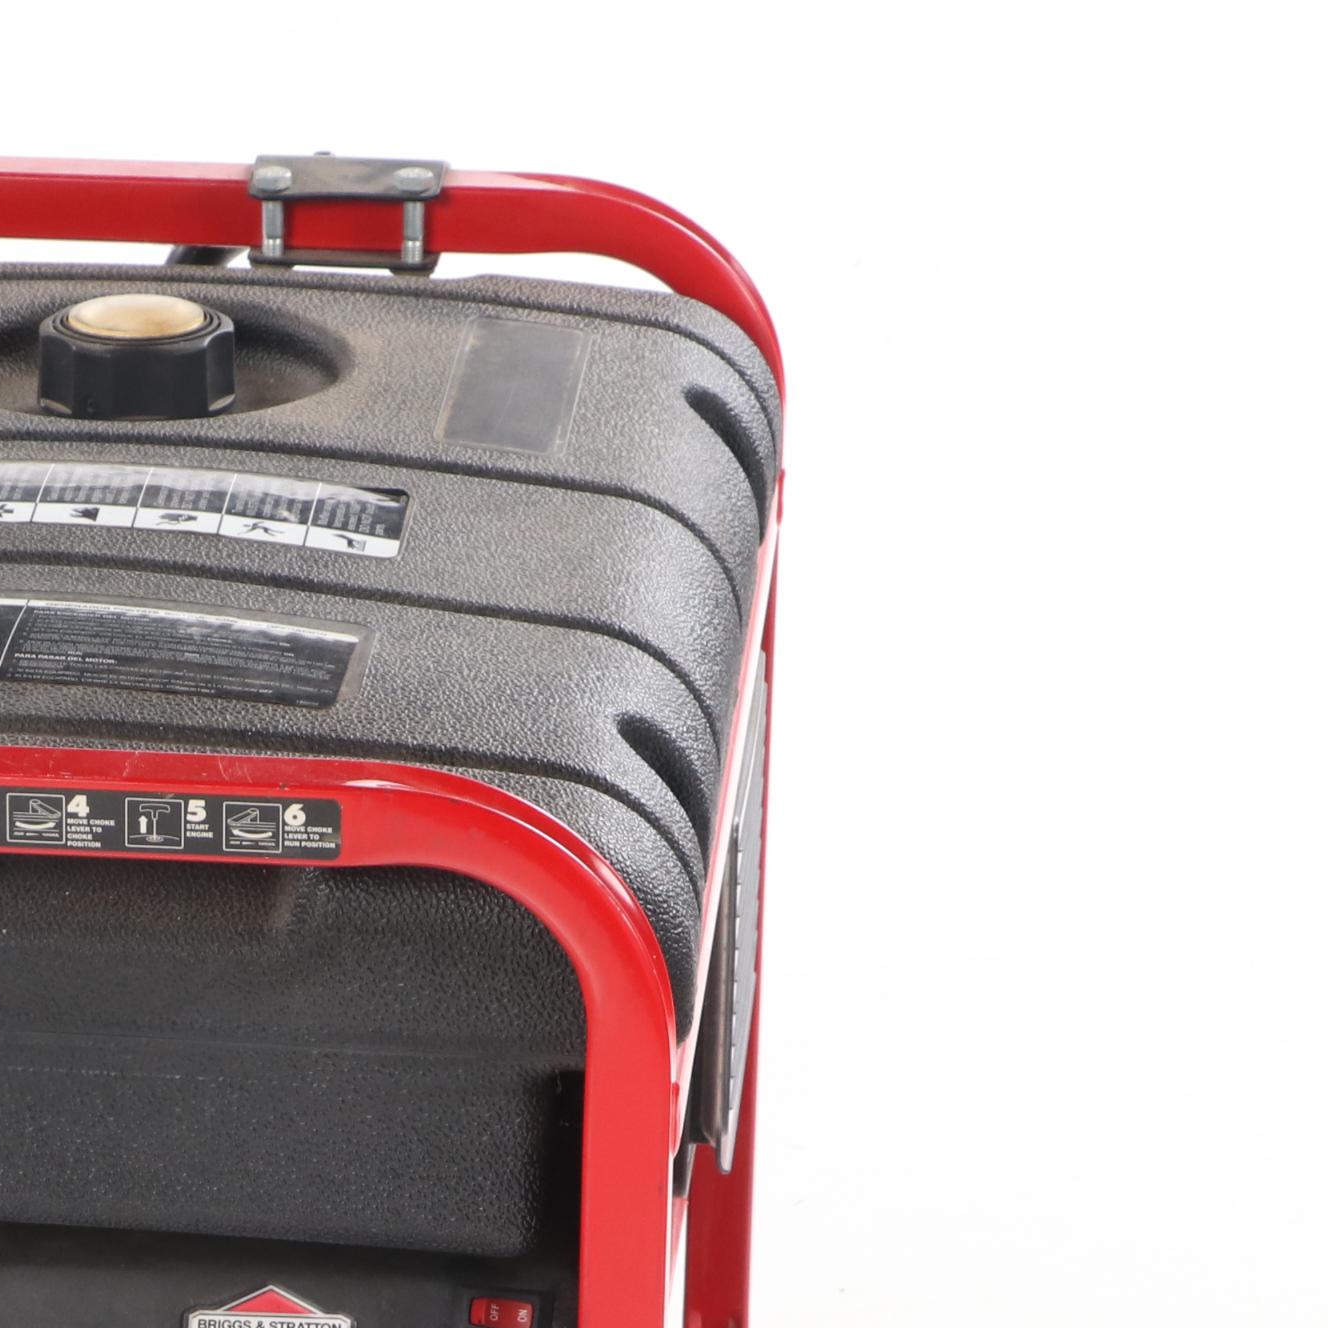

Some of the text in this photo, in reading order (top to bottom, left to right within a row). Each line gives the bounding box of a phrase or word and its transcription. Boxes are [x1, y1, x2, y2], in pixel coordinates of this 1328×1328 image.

[67, 795, 90, 817] 4
[186, 799, 207, 822] 5
[284, 803, 306, 826] 6
[490, 1304, 499, 1320] OFF
[517, 1309, 528, 1322] ON
